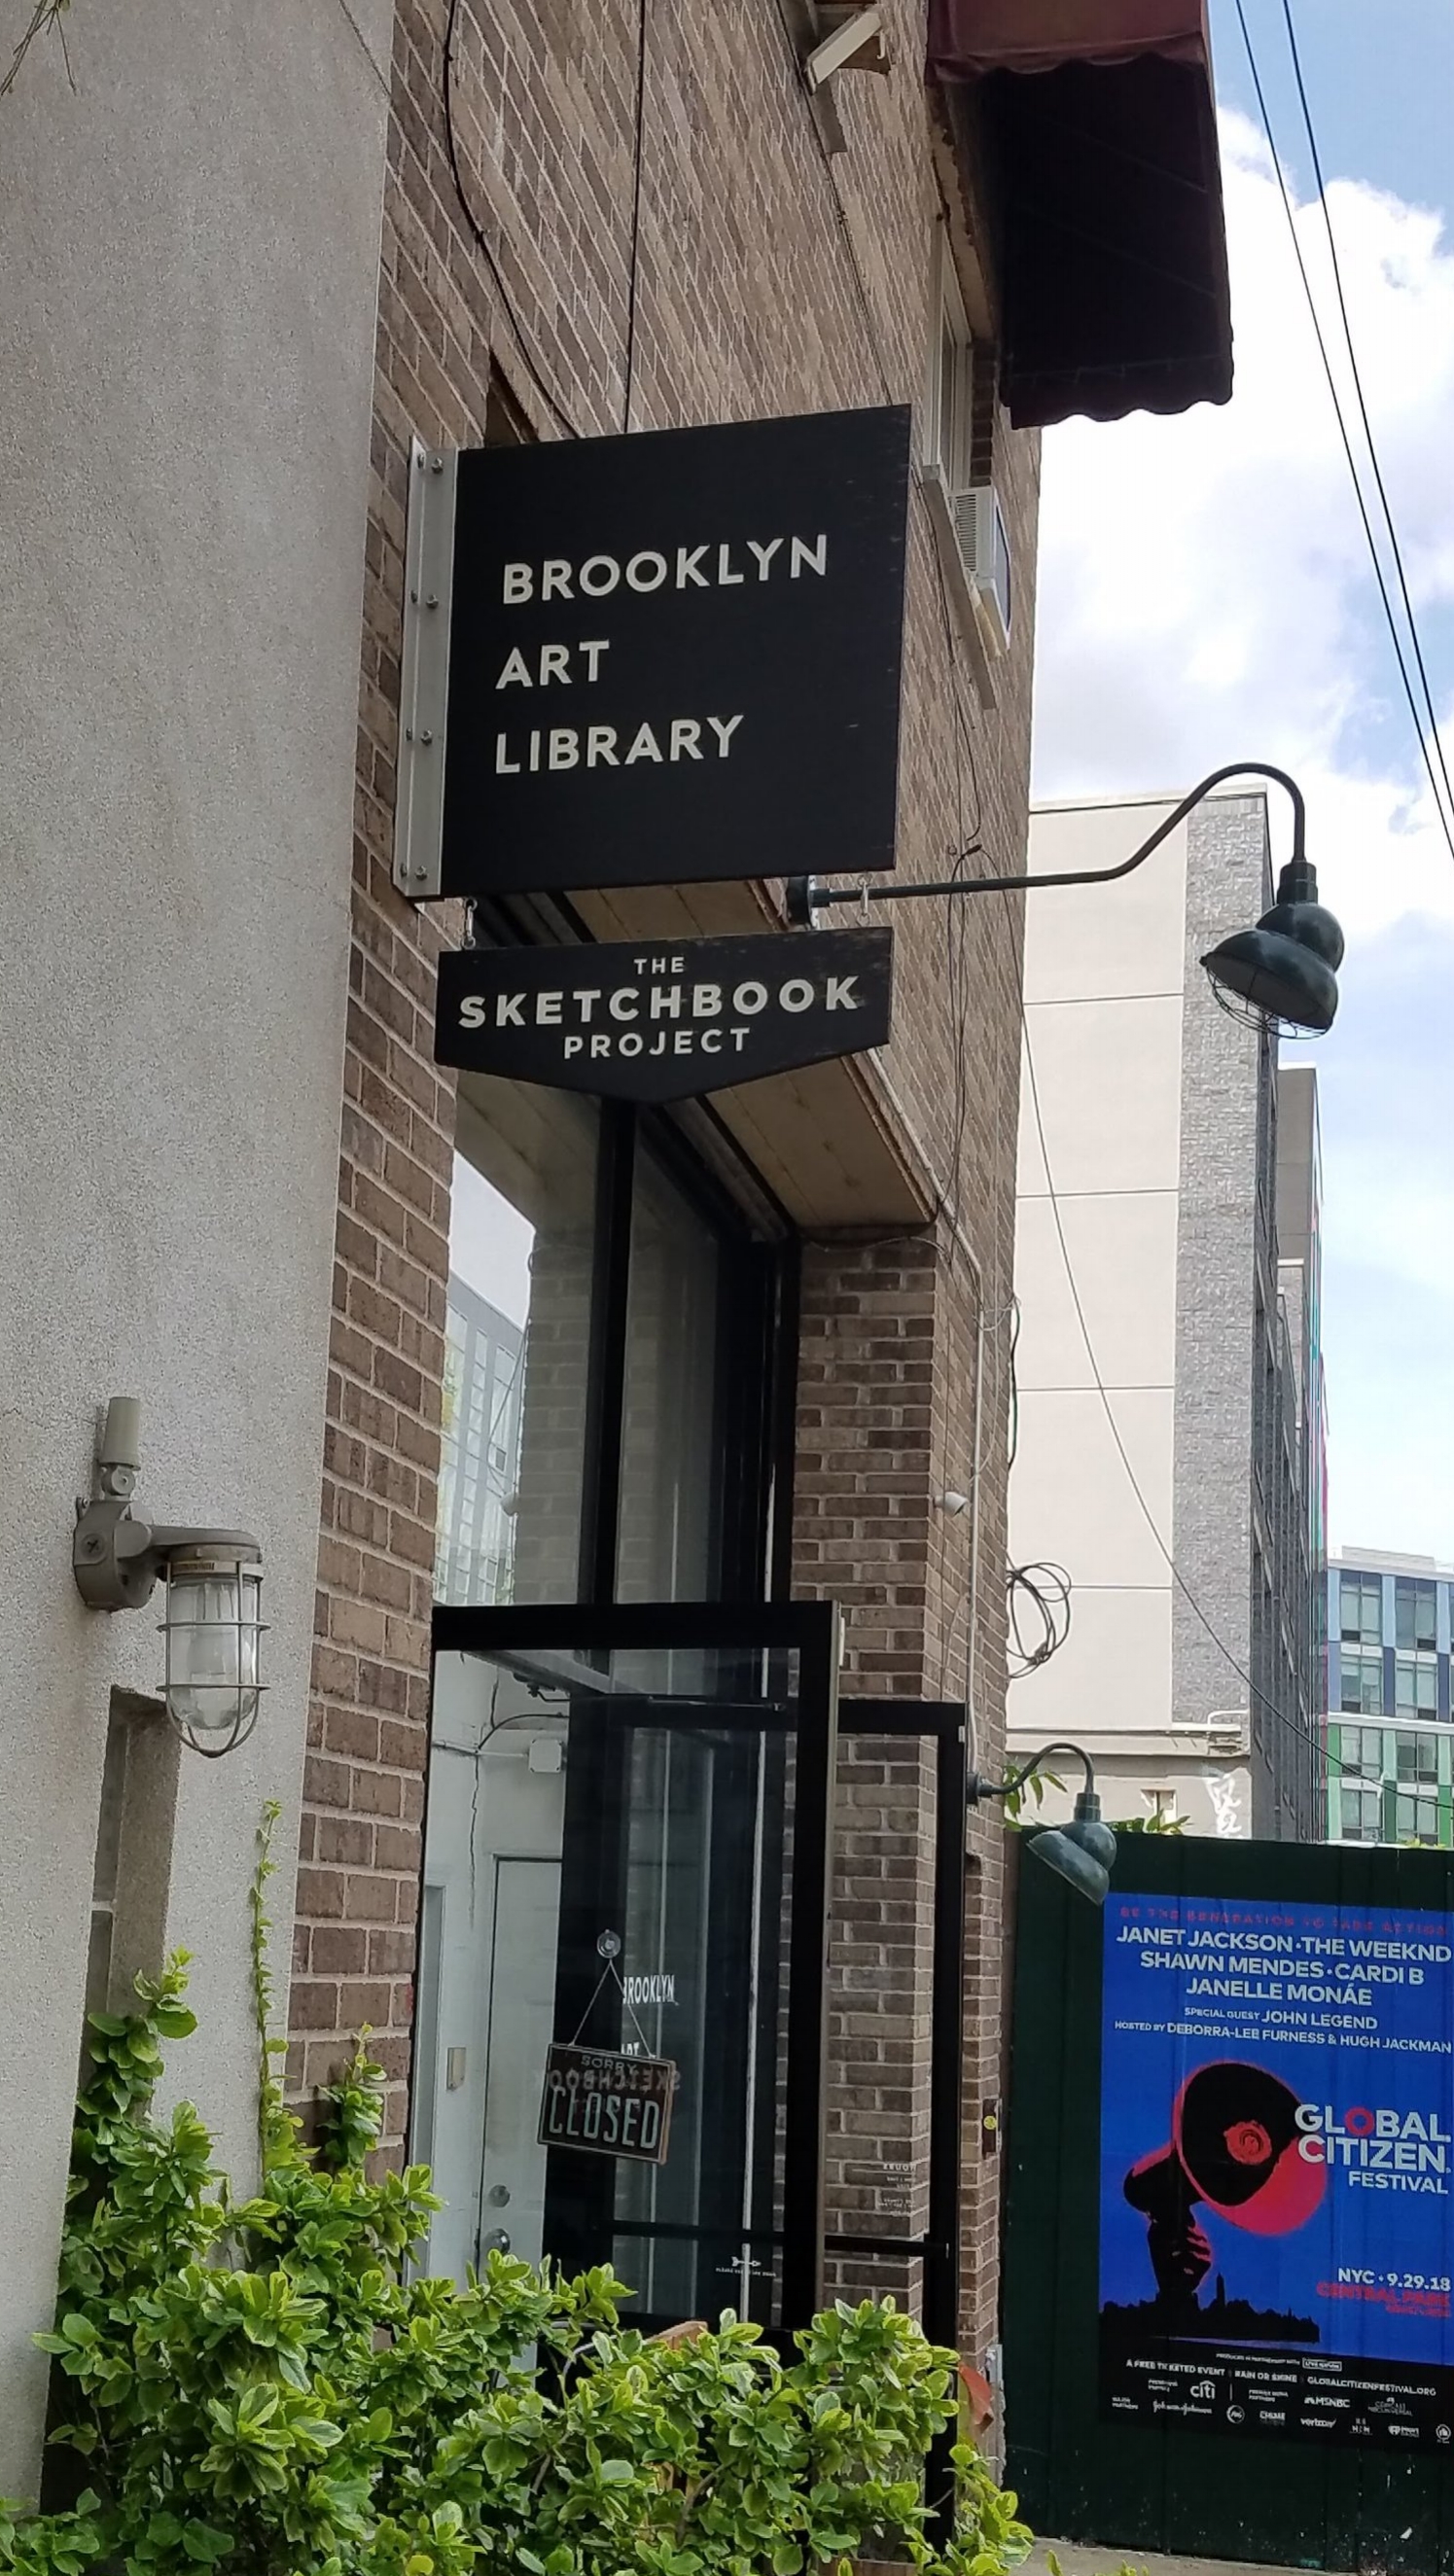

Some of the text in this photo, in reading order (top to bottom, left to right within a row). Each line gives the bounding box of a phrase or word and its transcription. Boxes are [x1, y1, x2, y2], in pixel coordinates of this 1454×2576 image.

[503, 534, 828, 605] BROOKLYN
[496, 640, 610, 689] ART
[496, 714, 744, 774] LIBRARY
[634, 955, 685, 975] THE
[459, 975, 859, 1030] SKETCHBOOK
[563, 1026, 751, 1060] PROJECT
[1116, 1925, 1452, 1962] JANET JACKSON THE WEEKND
[1140, 1951, 1424, 1985] SHAWN MENDES CARDI B
[1187, 1978, 1372, 2006] JANELLE MONÁE
[1184, 2006, 1378, 2029] SPECIAL GUEST JOHN LEGEND
[1115, 2020, 1451, 2054] HOSTED BY DEBORRA-LEE FURNESS & HUGH JACKMAN
[581, 2055, 639, 2076] SORRY
[549, 2086, 659, 2149] CLOSED
[1294, 2103, 1451, 2143] GLOBAL
[1348, 2170, 1448, 2195] FESTIVAL
[1338, 2268, 1451, 2292] NYC 9.29.18
[1125, 2358, 1133, 2367] A
[1134, 2359, 1156, 2370] FREE
[1197, 2366, 1225, 2377] EVENT
[1234, 2369, 1256, 2380] RAIN
[1189, 2381, 1216, 2399] citi
[1307, 2376, 1436, 2397] GLOBALCITIZENFESTIVAL.ORG
[1313, 2395, 1351, 2409] MSNBC
